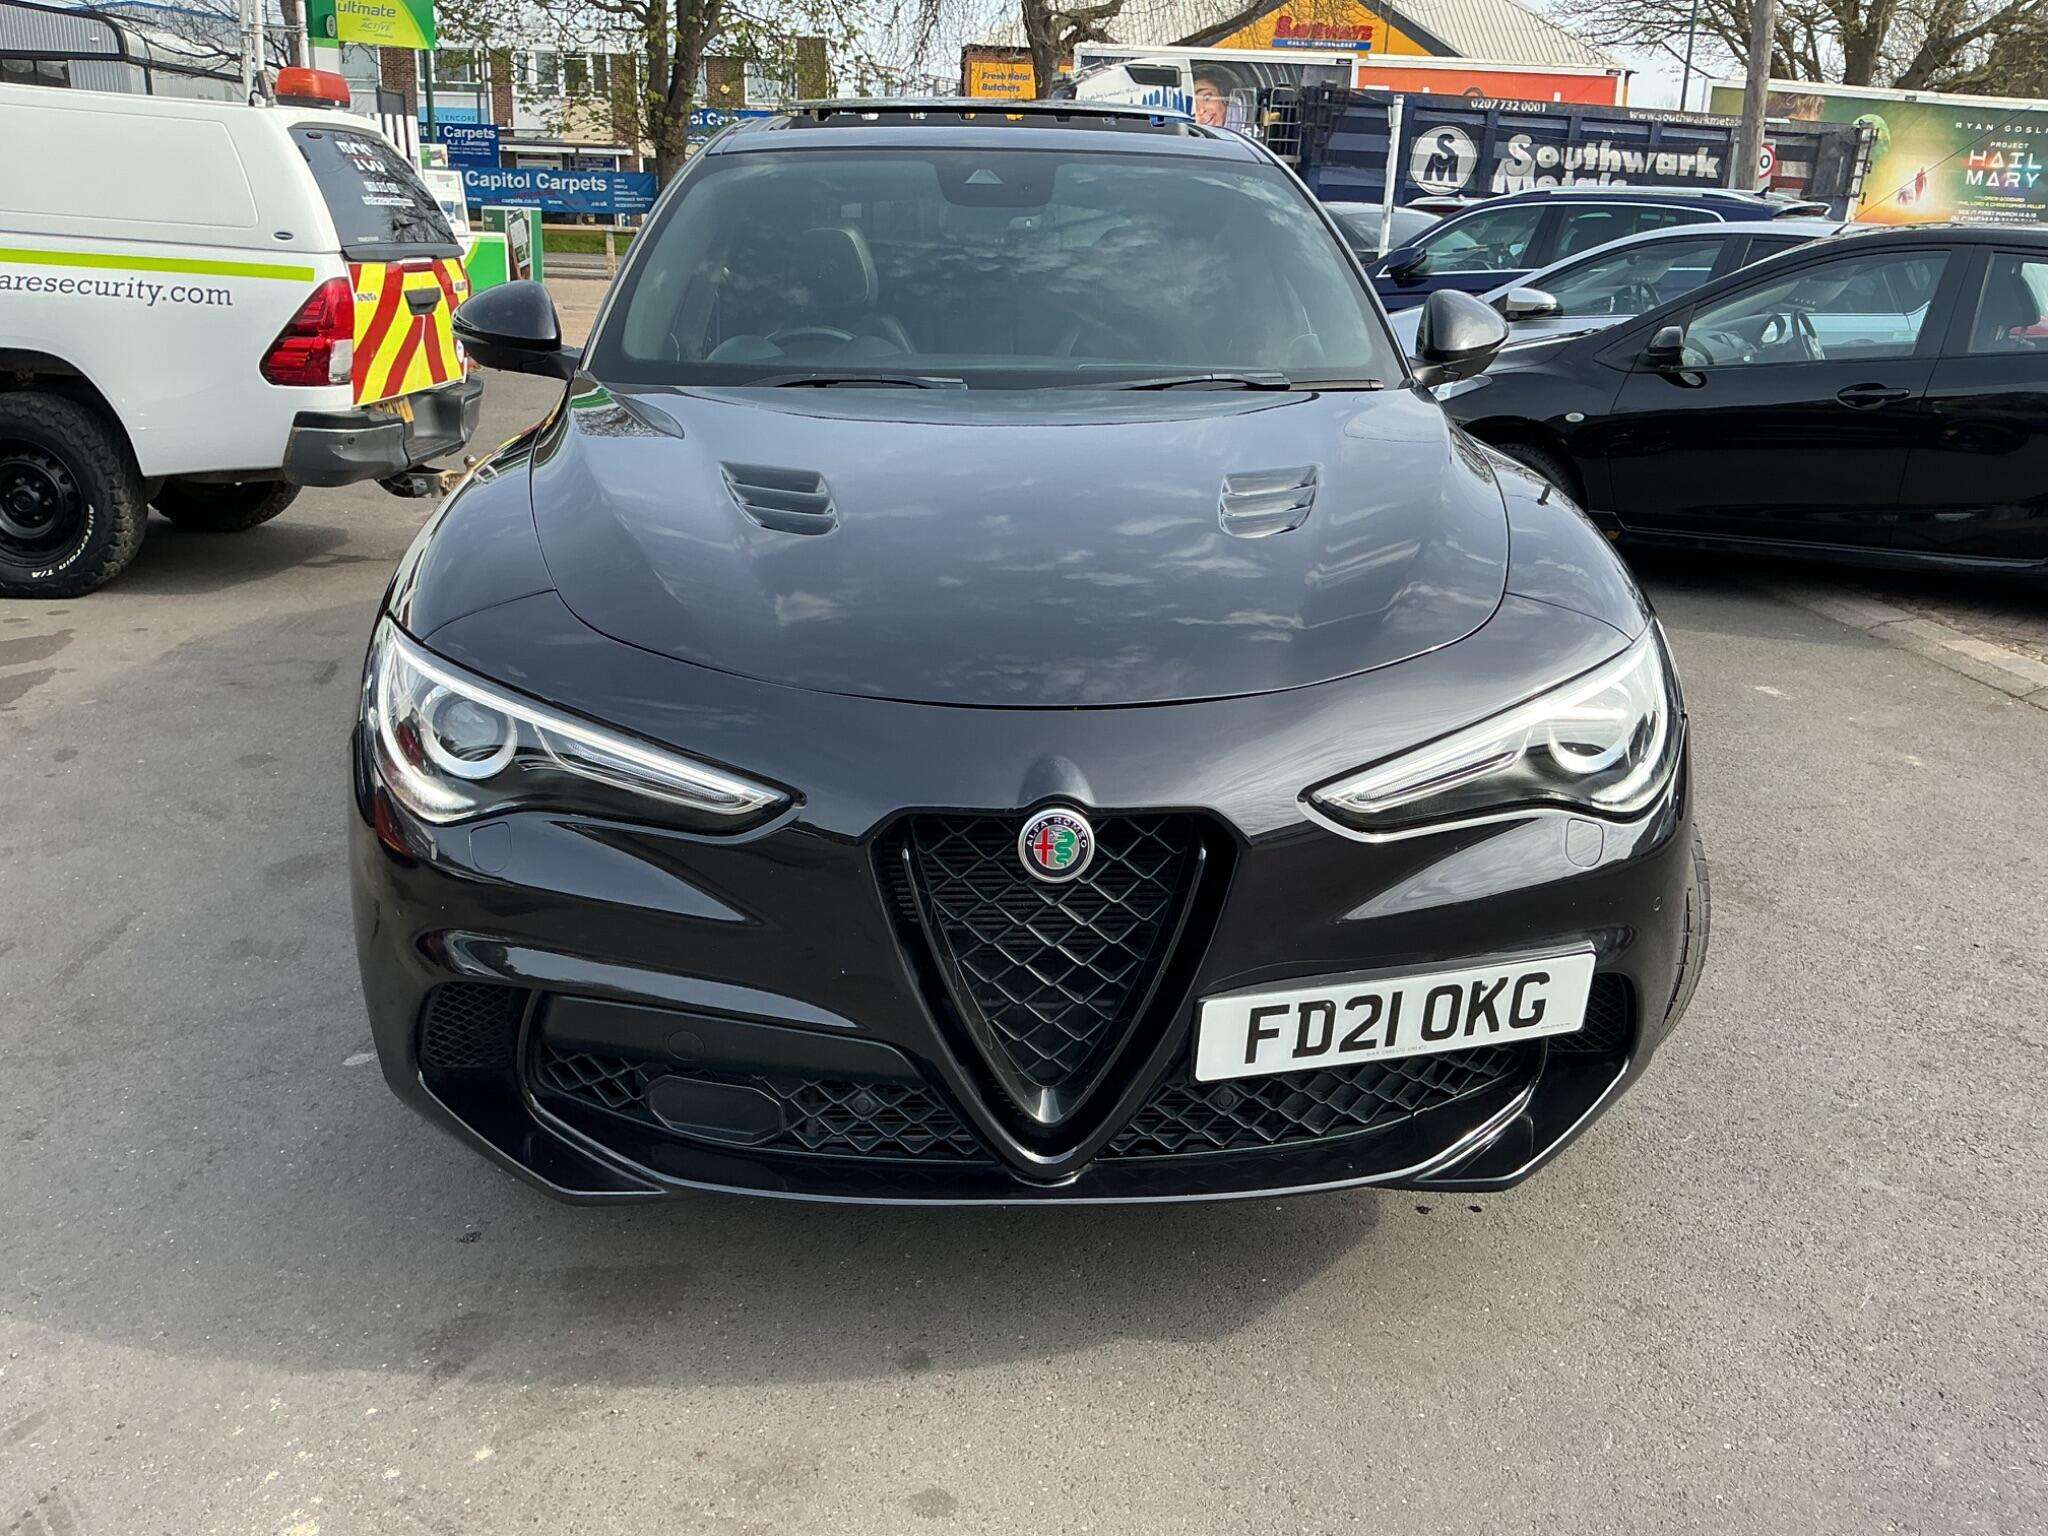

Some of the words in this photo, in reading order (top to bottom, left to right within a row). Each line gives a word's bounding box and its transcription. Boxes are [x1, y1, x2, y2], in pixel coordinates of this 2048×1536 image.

[337, 1, 396, 17] ultimate
[1471, 98, 1498, 110] 0207
[1500, 100, 1520, 111] 732
[1521, 101, 1547, 113] 0001
[443, 125, 496, 141] Carpets
[1955, 122, 1994, 131] RYAN
[1989, 141, 2030, 150] PROJECT
[1504, 133, 1720, 179] Southwark
[1967, 149, 2043, 170] HAIL
[464, 170, 531, 191] Capitol
[536, 173, 607, 194] Carpets
[1965, 169, 2041, 188] MARY
[1026, 820, 1049, 848] ALFA
[1053, 816, 1088, 849] ROMEO
[1244, 989, 1404, 1064] FD21
[1420, 971, 1552, 1042] OKG
